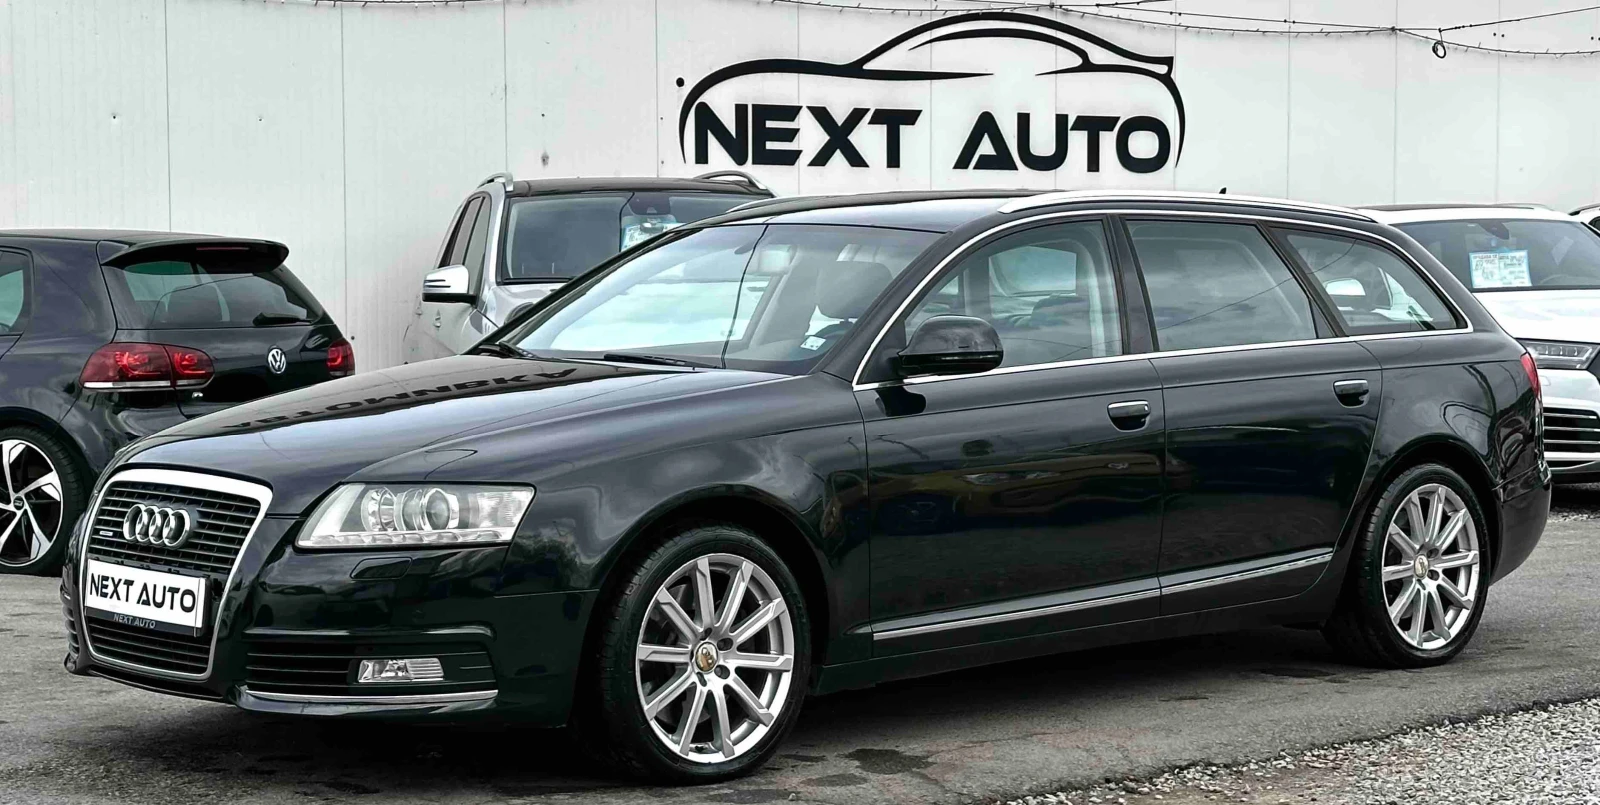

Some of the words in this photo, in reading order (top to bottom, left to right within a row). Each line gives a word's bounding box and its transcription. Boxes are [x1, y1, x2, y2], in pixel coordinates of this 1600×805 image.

[695, 101, 923, 168] NEXT
[952, 111, 1171, 174] AUTO
[90, 573, 134, 602] NEXT
[136, 582, 196, 613] AUTO
[114, 614, 133, 625] NEXT
[133, 618, 156, 629] AUTO
